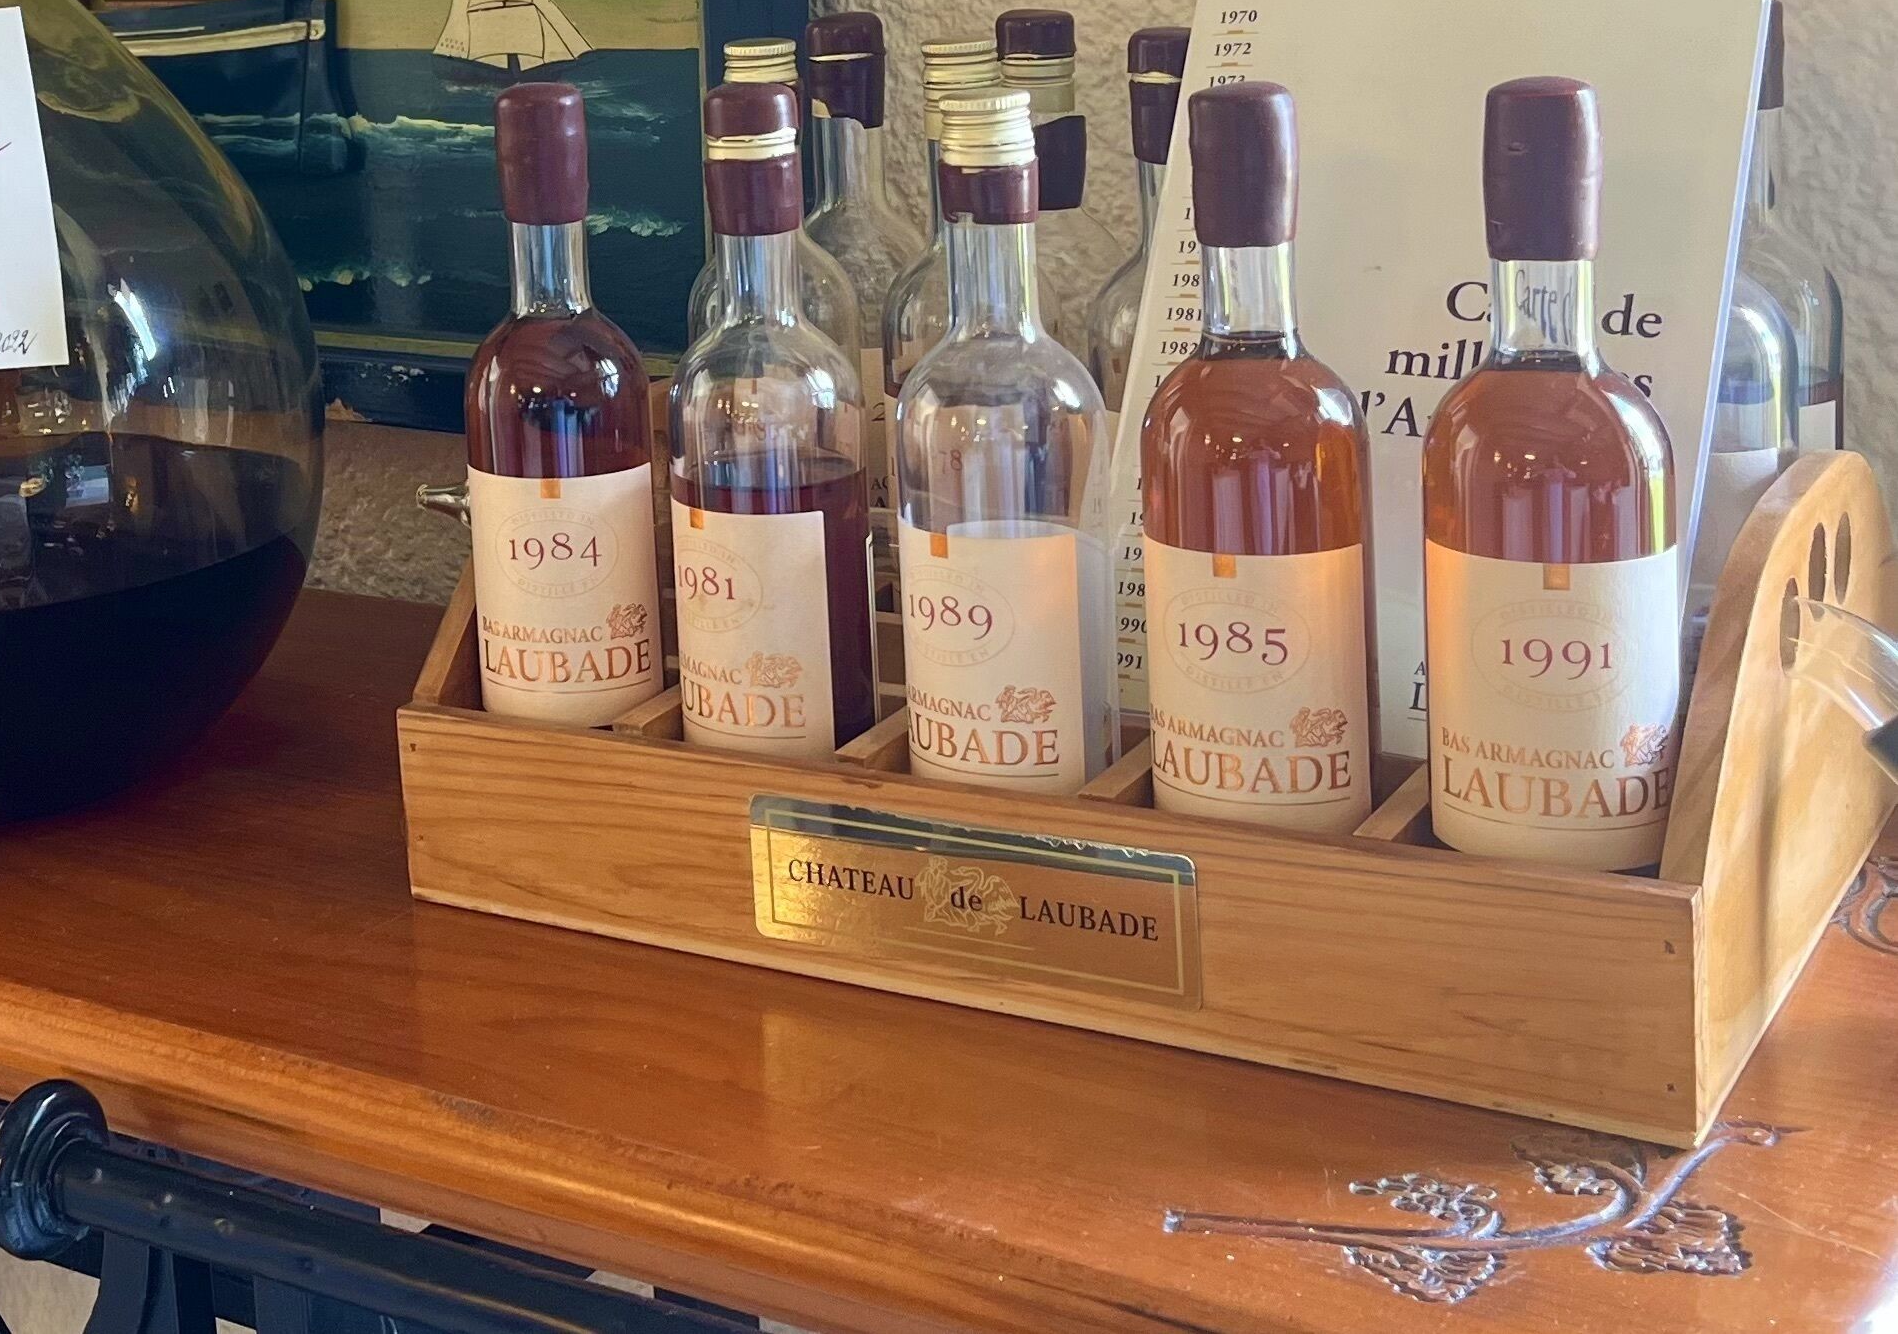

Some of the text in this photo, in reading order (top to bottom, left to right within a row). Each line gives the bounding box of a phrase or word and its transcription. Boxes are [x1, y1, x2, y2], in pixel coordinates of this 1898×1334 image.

[1220, 9, 1258, 25] 1970
[1214, 42, 1252, 57] 1972
[1172, 273, 1200, 287] 198
[1166, 307, 1202, 322] 1981
[1601, 294, 1662, 338] de
[509, 532, 602, 571] 1984
[678, 565, 736, 600] 1981
[1118, 581, 1145, 597] 198
[502, 625, 603, 644] ARMAGNAC
[909, 594, 993, 641] 1989
[484, 638, 652, 683] LAUBADE
[1178, 621, 1288, 666] 1985
[1501, 638, 1612, 680] 1991
[1167, 715, 1285, 748] ARMAGNAC
[1441, 726, 1615, 770] BAS ARMAGNAC
[1151, 729, 1351, 795] LAUBADE
[1442, 754, 1671, 818] LAUBADE
[788, 858, 1160, 943] CHATEAU de LAUBADE
